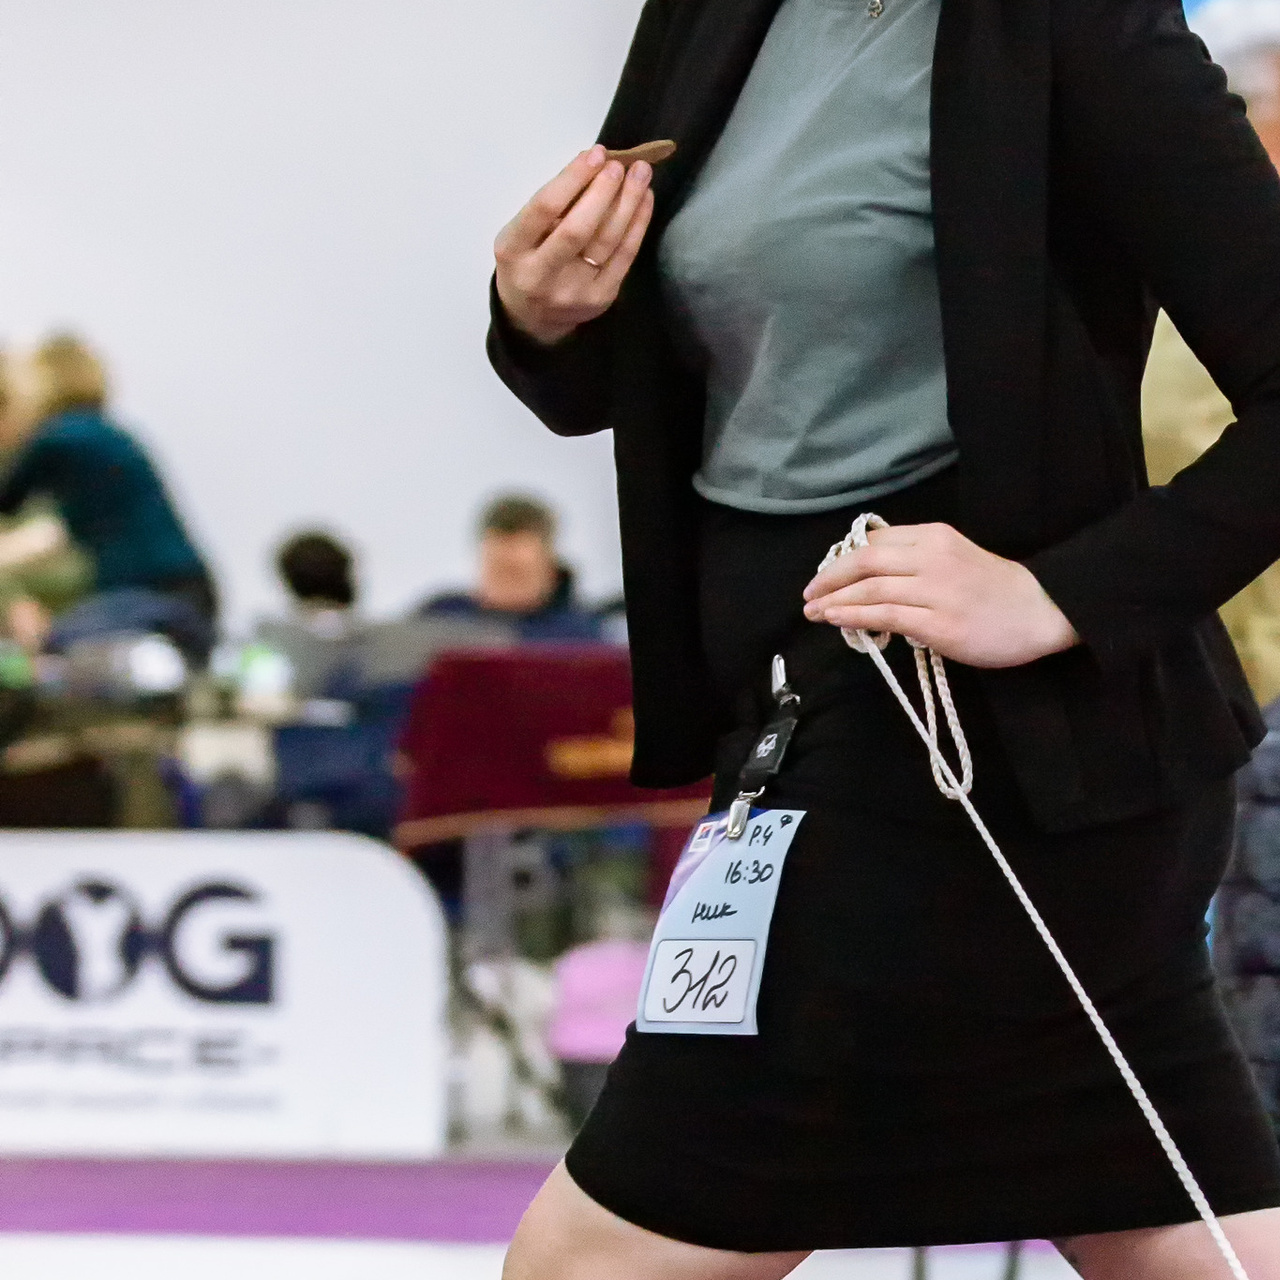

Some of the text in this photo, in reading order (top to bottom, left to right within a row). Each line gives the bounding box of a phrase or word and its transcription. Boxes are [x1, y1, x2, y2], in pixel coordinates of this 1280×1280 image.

[724, 859, 774, 885] 16:30
[0, 872, 276, 1006] OG
[662, 947, 738, 1014] 312
